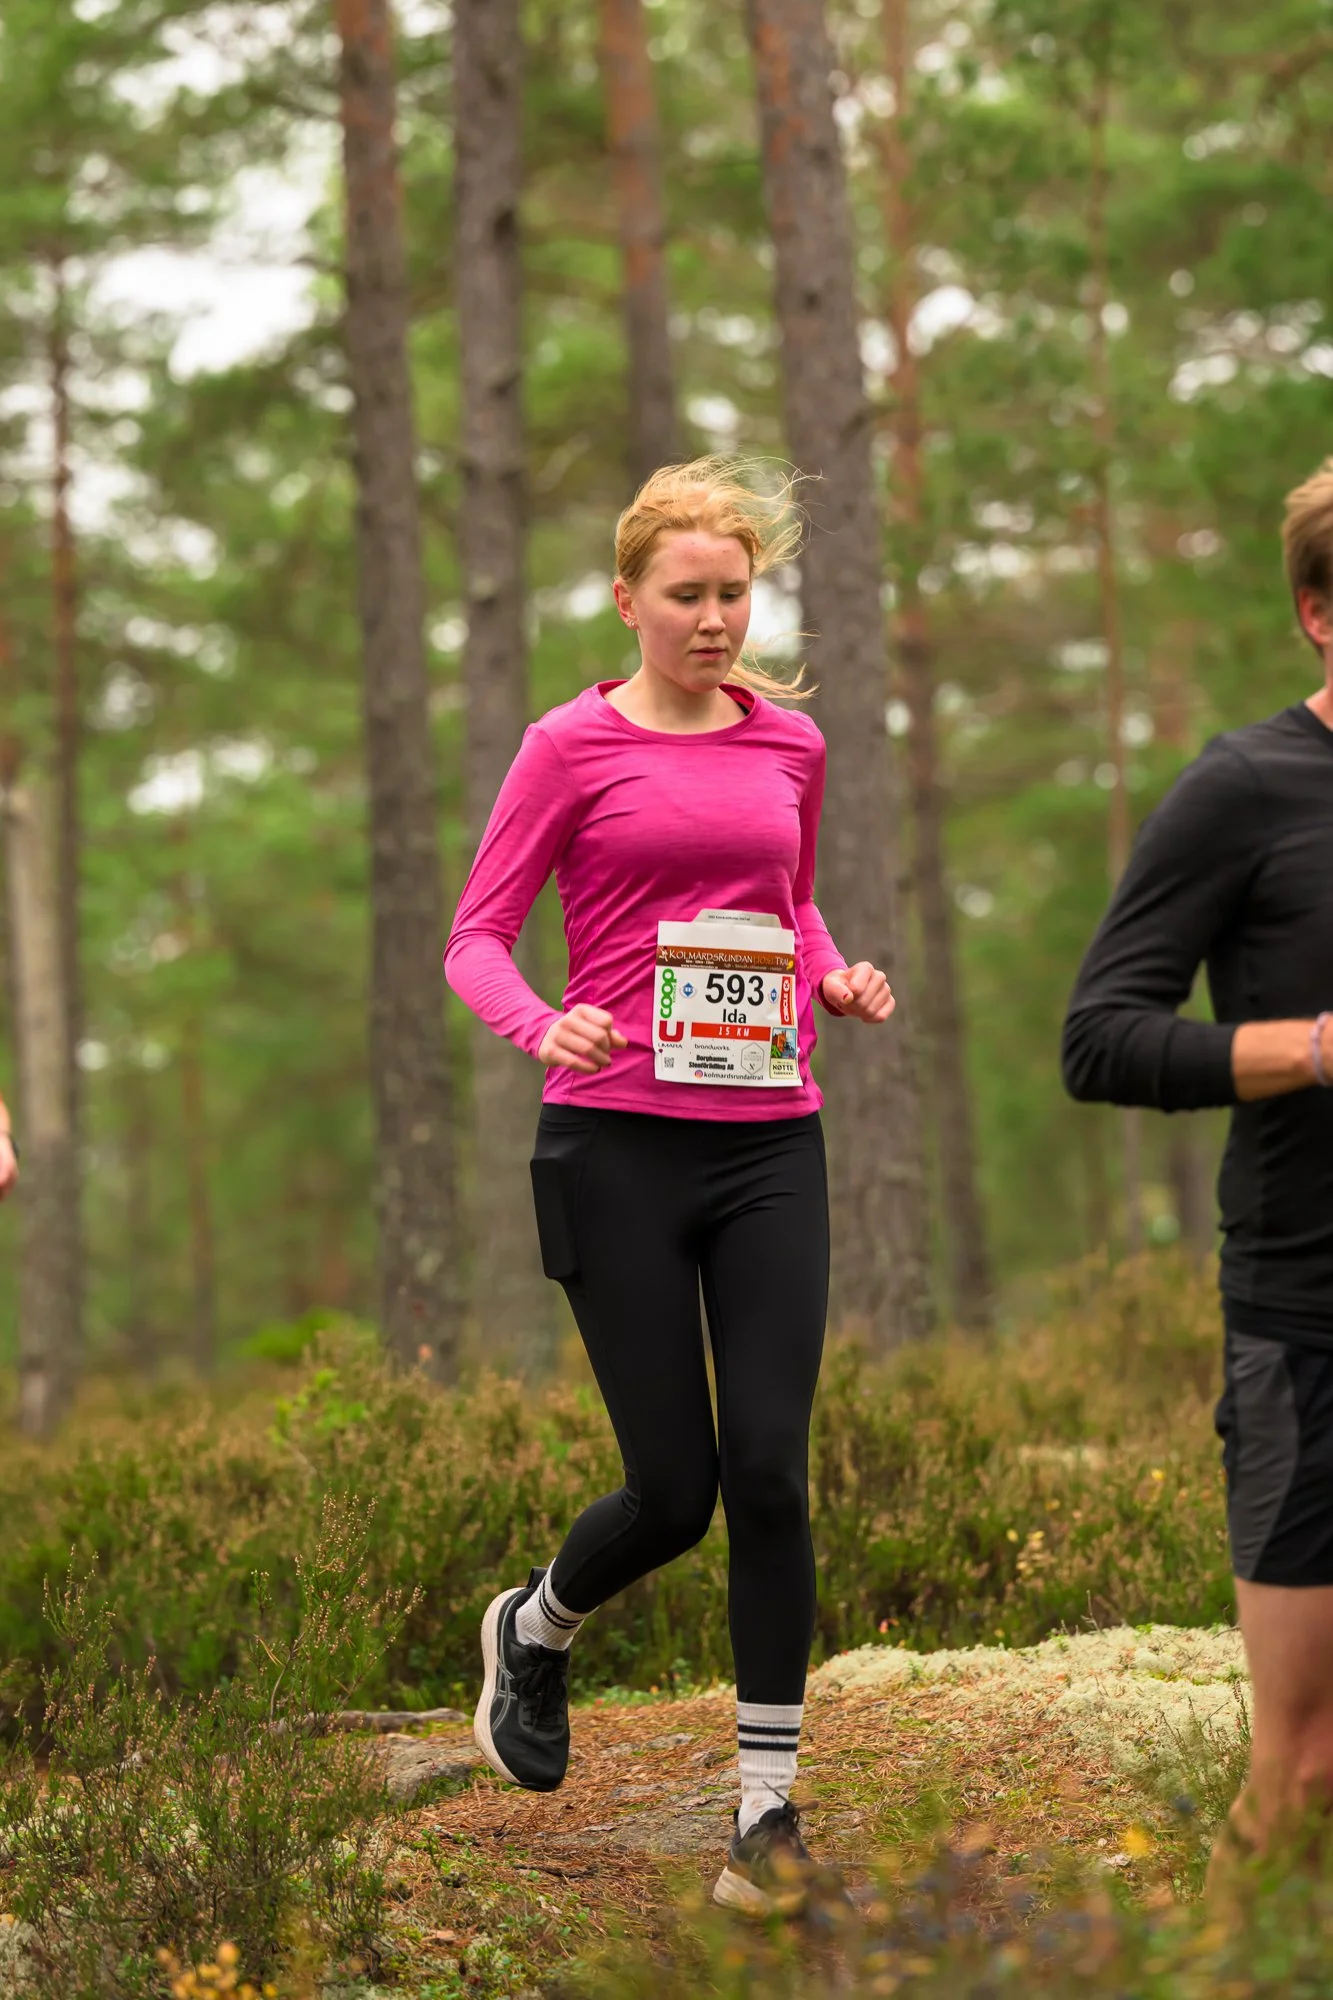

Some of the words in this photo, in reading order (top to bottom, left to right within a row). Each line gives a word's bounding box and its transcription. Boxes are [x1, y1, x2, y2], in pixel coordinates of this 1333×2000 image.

[660, 968, 677, 1018] coop
[705, 973, 764, 1006] 593
[723, 1009, 746, 1024] Ida
[718, 1026, 730, 1036] 15
[737, 1027, 750, 1037] KM
